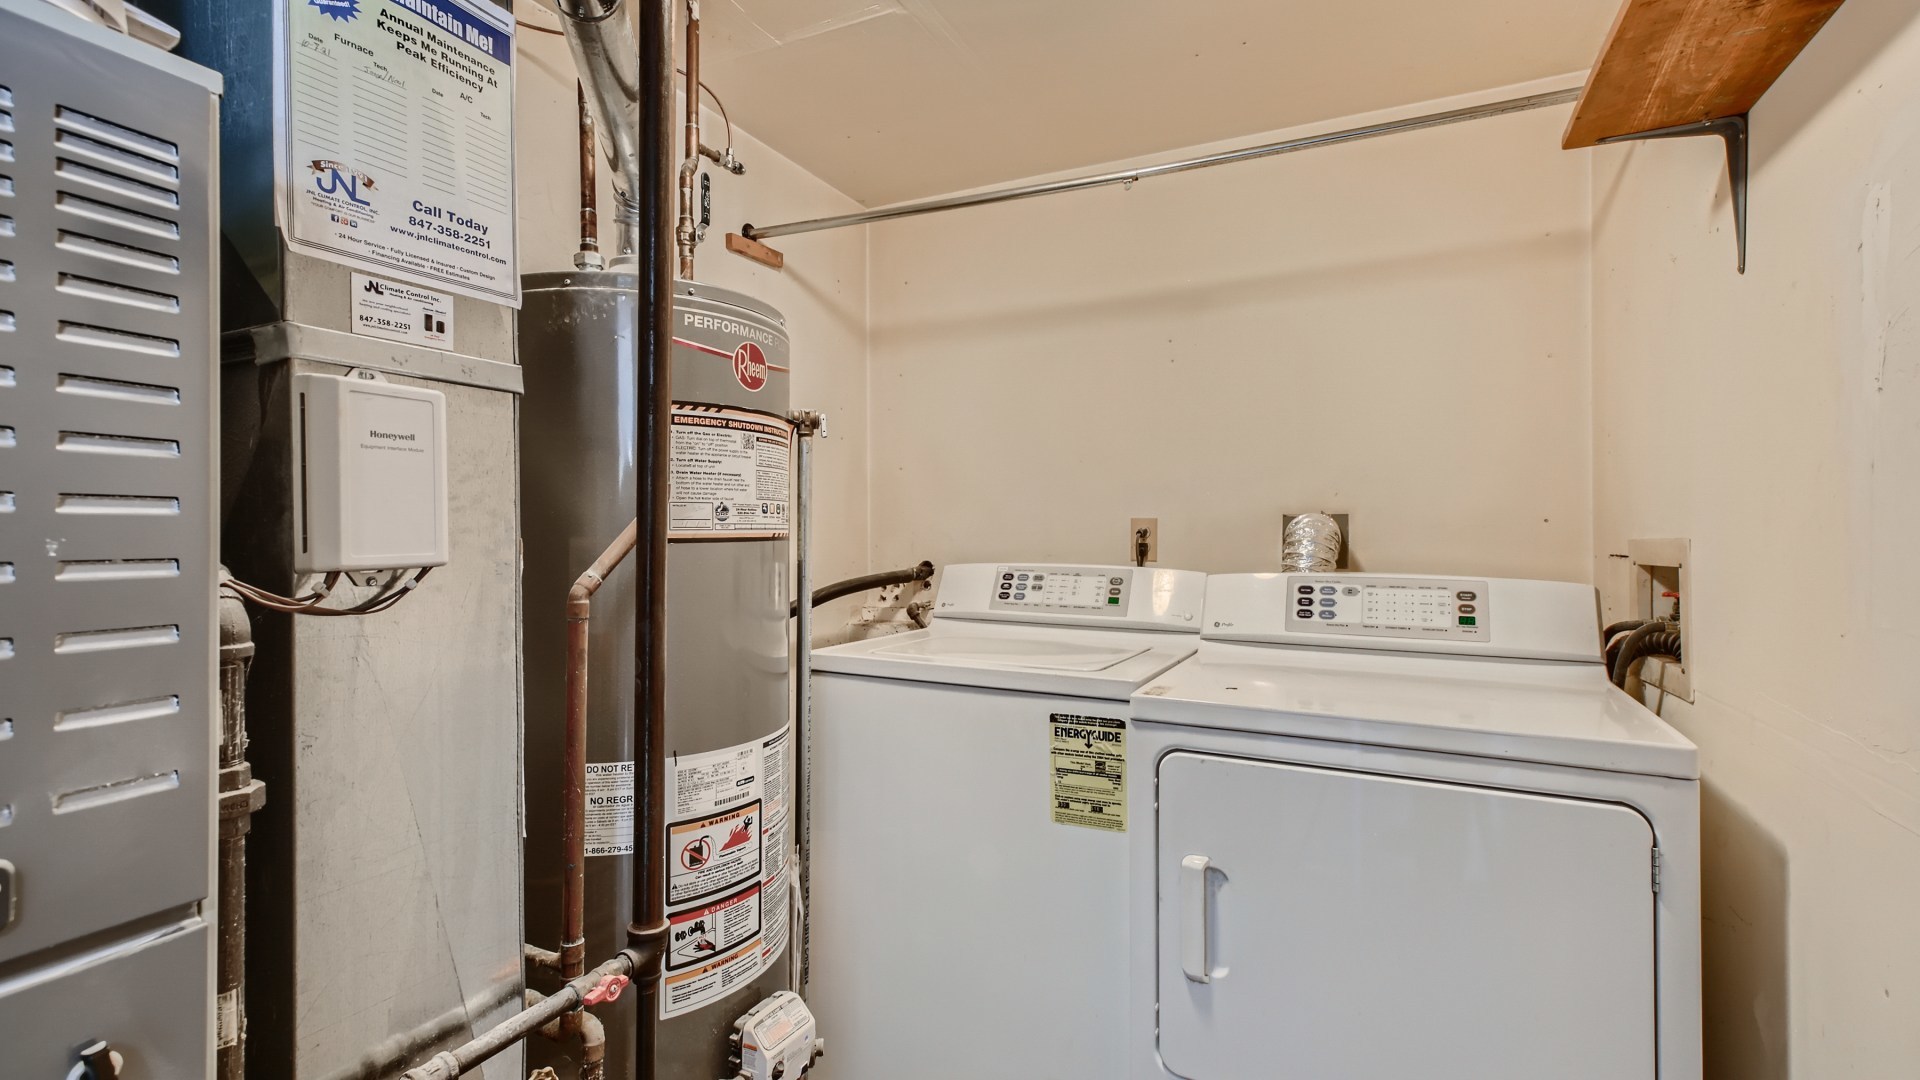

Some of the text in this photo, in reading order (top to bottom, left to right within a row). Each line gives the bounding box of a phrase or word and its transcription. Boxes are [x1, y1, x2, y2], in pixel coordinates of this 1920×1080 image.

[308, 32, 323, 43] Date
[334, 33, 374, 57] Furnace
[379, 8, 496, 76] Annual Maintenance
[465, 23, 493, 54] Me!
[376, 19, 498, 88] Keeps Me Running At
[373, 61, 388, 71] Tech
[396, 41, 483, 93] Peak Efficiency
[431, 88, 444, 97] Date
[459, 92, 473, 104] A/C
[480, 112, 491, 121] Tech
[320, 161, 343, 170] Since
[316, 167, 370, 206] JNL
[412, 200, 489, 235] Call Today
[408, 216, 491, 249] 847-358-2251
[390, 226, 507, 266] www.jnlclimatecontrol.com
[347, 235, 363, 244] Hour
[363, 239, 386, 250] Service
[390, 247, 404, 256] Fully
[405, 251, 430, 262] Licensed
[459, 266, 479, 276] Custom
[371, 250, 471, 281] Financing Available FREE Estimates
[379, 283, 404, 295] Climate
[405, 290, 430, 300] Control
[430, 295, 442, 303] Inc.
[359, 314, 411, 330] 847-358-2251
[684, 313, 774, 346] PERFORMANCE
[738, 343, 766, 383] Rheem
[674, 416, 727, 427] EMERGENCY
[727, 419, 763, 432] SHUTDOWN
[370, 430, 416, 441] Honeywell
[1054, 726, 1122, 743] ENERGYGUIDE
[586, 765, 599, 774] DO
[601, 764, 619, 773] NOT
[590, 797, 604, 805] NO
[708, 812, 740, 826] WARNING
[711, 898, 738, 913] DANGER
[711, 953, 739, 970] WARNING
